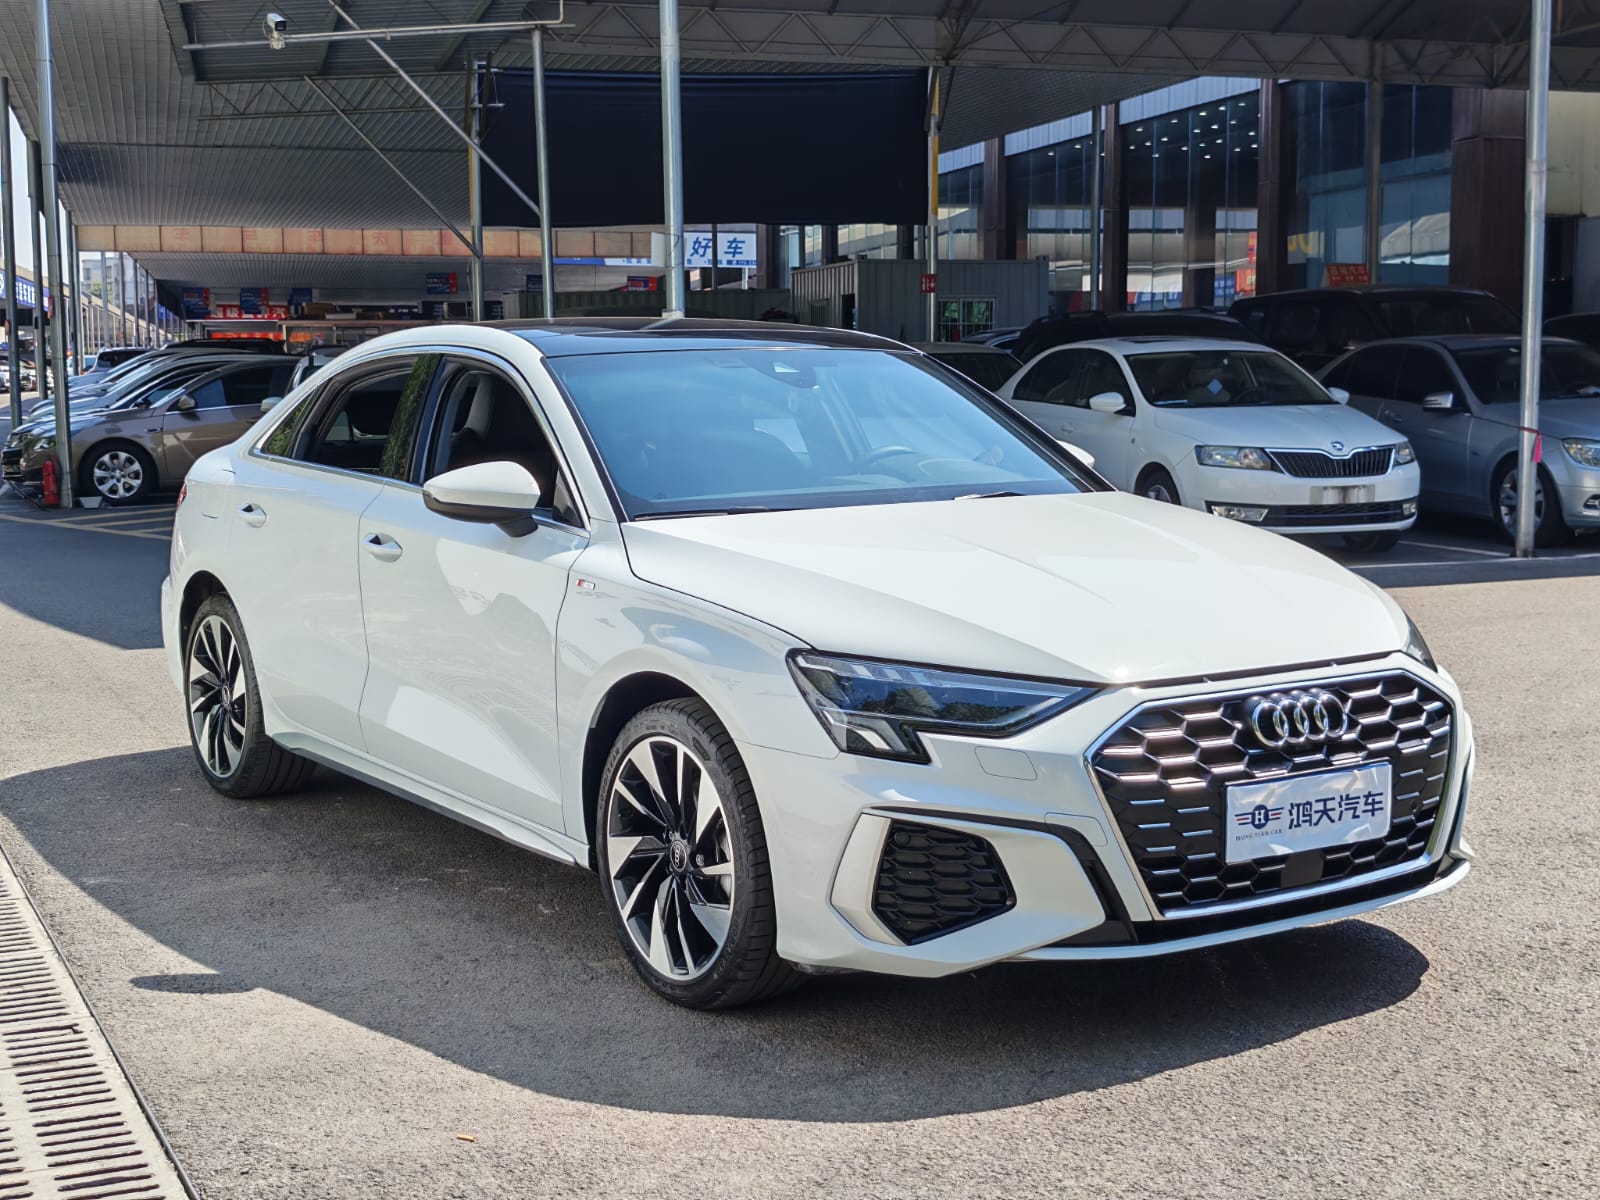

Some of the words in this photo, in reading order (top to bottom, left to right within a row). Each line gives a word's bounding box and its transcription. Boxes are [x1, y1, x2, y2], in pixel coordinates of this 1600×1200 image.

[1254, 809, 1266, 825] H
[1288, 791, 1384, 829] 鸿天汽车
